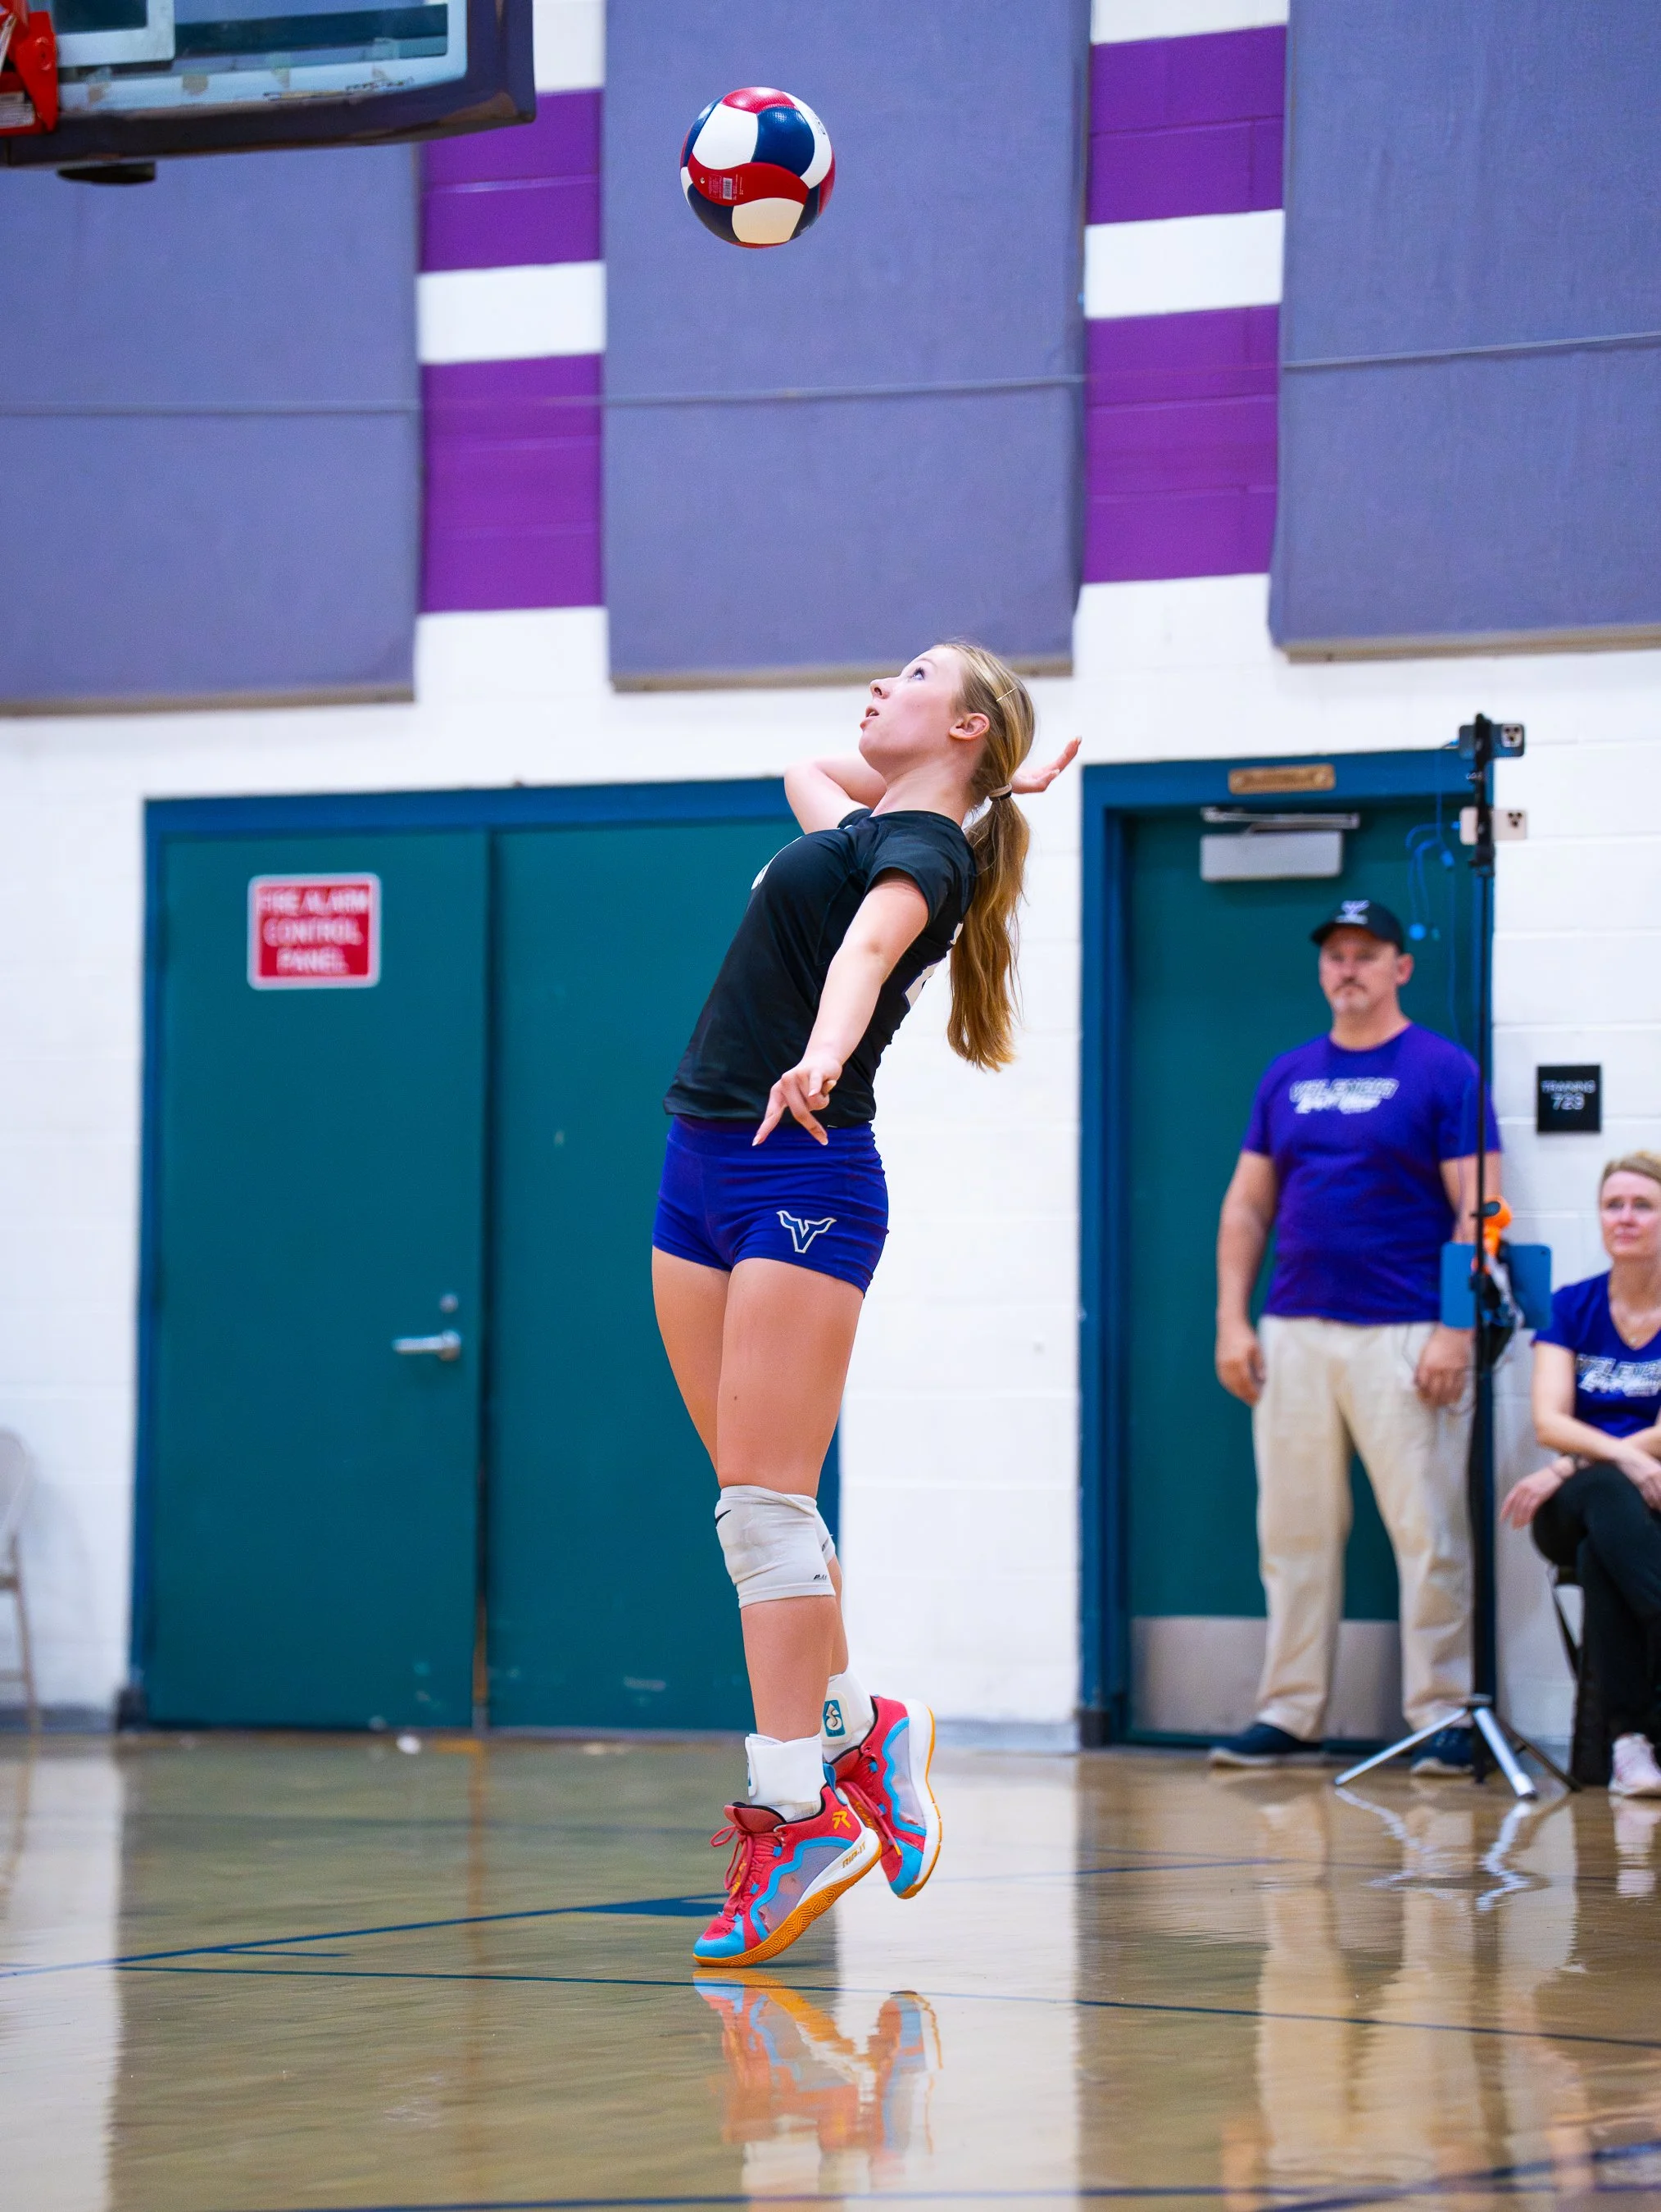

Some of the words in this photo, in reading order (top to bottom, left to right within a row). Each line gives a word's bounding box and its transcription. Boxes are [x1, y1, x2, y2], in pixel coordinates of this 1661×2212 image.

[301, 888, 369, 916] ALARM
[263, 917, 363, 946] CONTROL
[276, 947, 350, 975] PANEL
